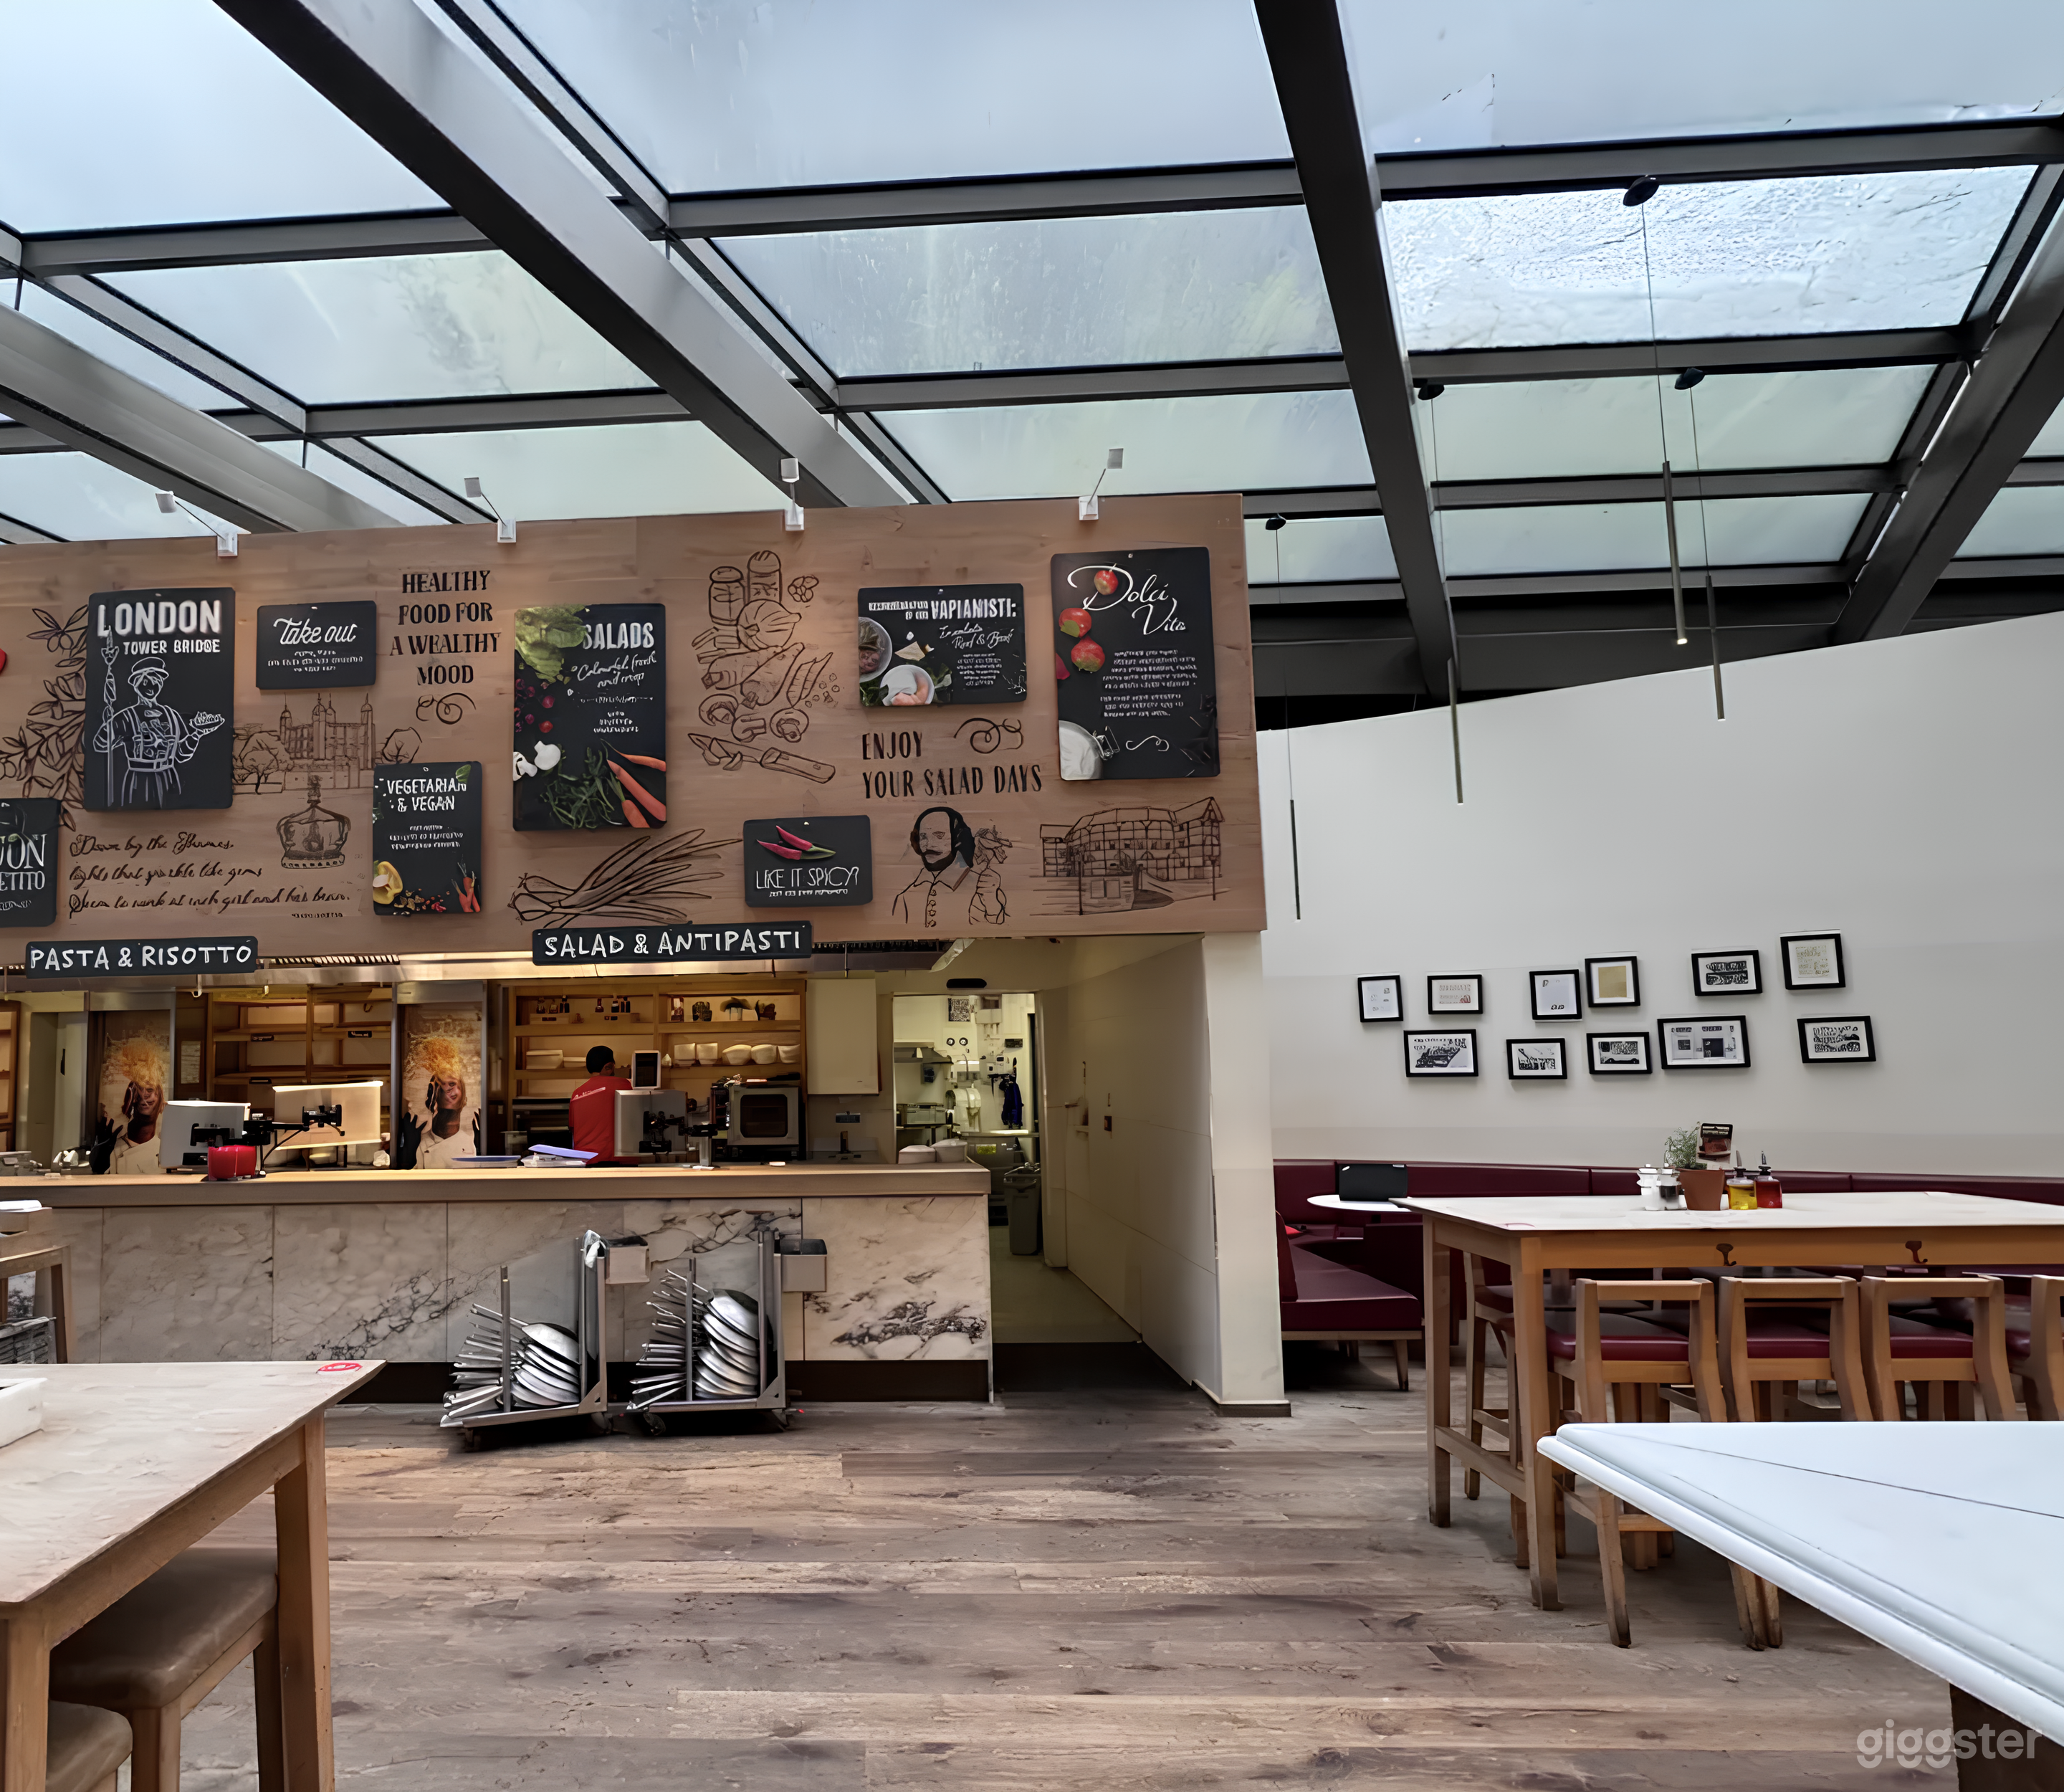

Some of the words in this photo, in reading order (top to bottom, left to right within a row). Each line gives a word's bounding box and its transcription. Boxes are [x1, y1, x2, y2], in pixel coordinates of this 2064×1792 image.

[401, 570, 491, 594] HEALTHY
[97, 599, 221, 637] LONDON
[398, 604, 451, 625] FOOD
[456, 602, 493, 623] FOR
[273, 617, 322, 645] Take
[325, 623, 358, 644] out
[582, 622, 655, 650] SALADS
[123, 639, 168, 655] TOWER
[173, 639, 221, 654] BRIDGE
[389, 636, 403, 656] A
[407, 632, 502, 654] WEALTHY
[416, 664, 474, 686] MOOD
[862, 730, 922, 760] ENJOY
[387, 778, 467, 794] VEGETARIAN
[862, 770, 914, 799] YOUR
[923, 767, 983, 796] SALAD
[994, 764, 1042, 793] DAYS
[397, 798, 408, 812] &
[411, 796, 455, 811] VEGAN
[756, 869, 785, 889] LIKE
[791, 868, 803, 887] IT
[545, 933, 624, 958] SALAD
[634, 933, 649, 955] &
[657, 928, 801, 955] ANTIPASTI
[30, 946, 110, 971] PASTA
[118, 947, 133, 968] &
[142, 945, 252, 967] RISOTTO
